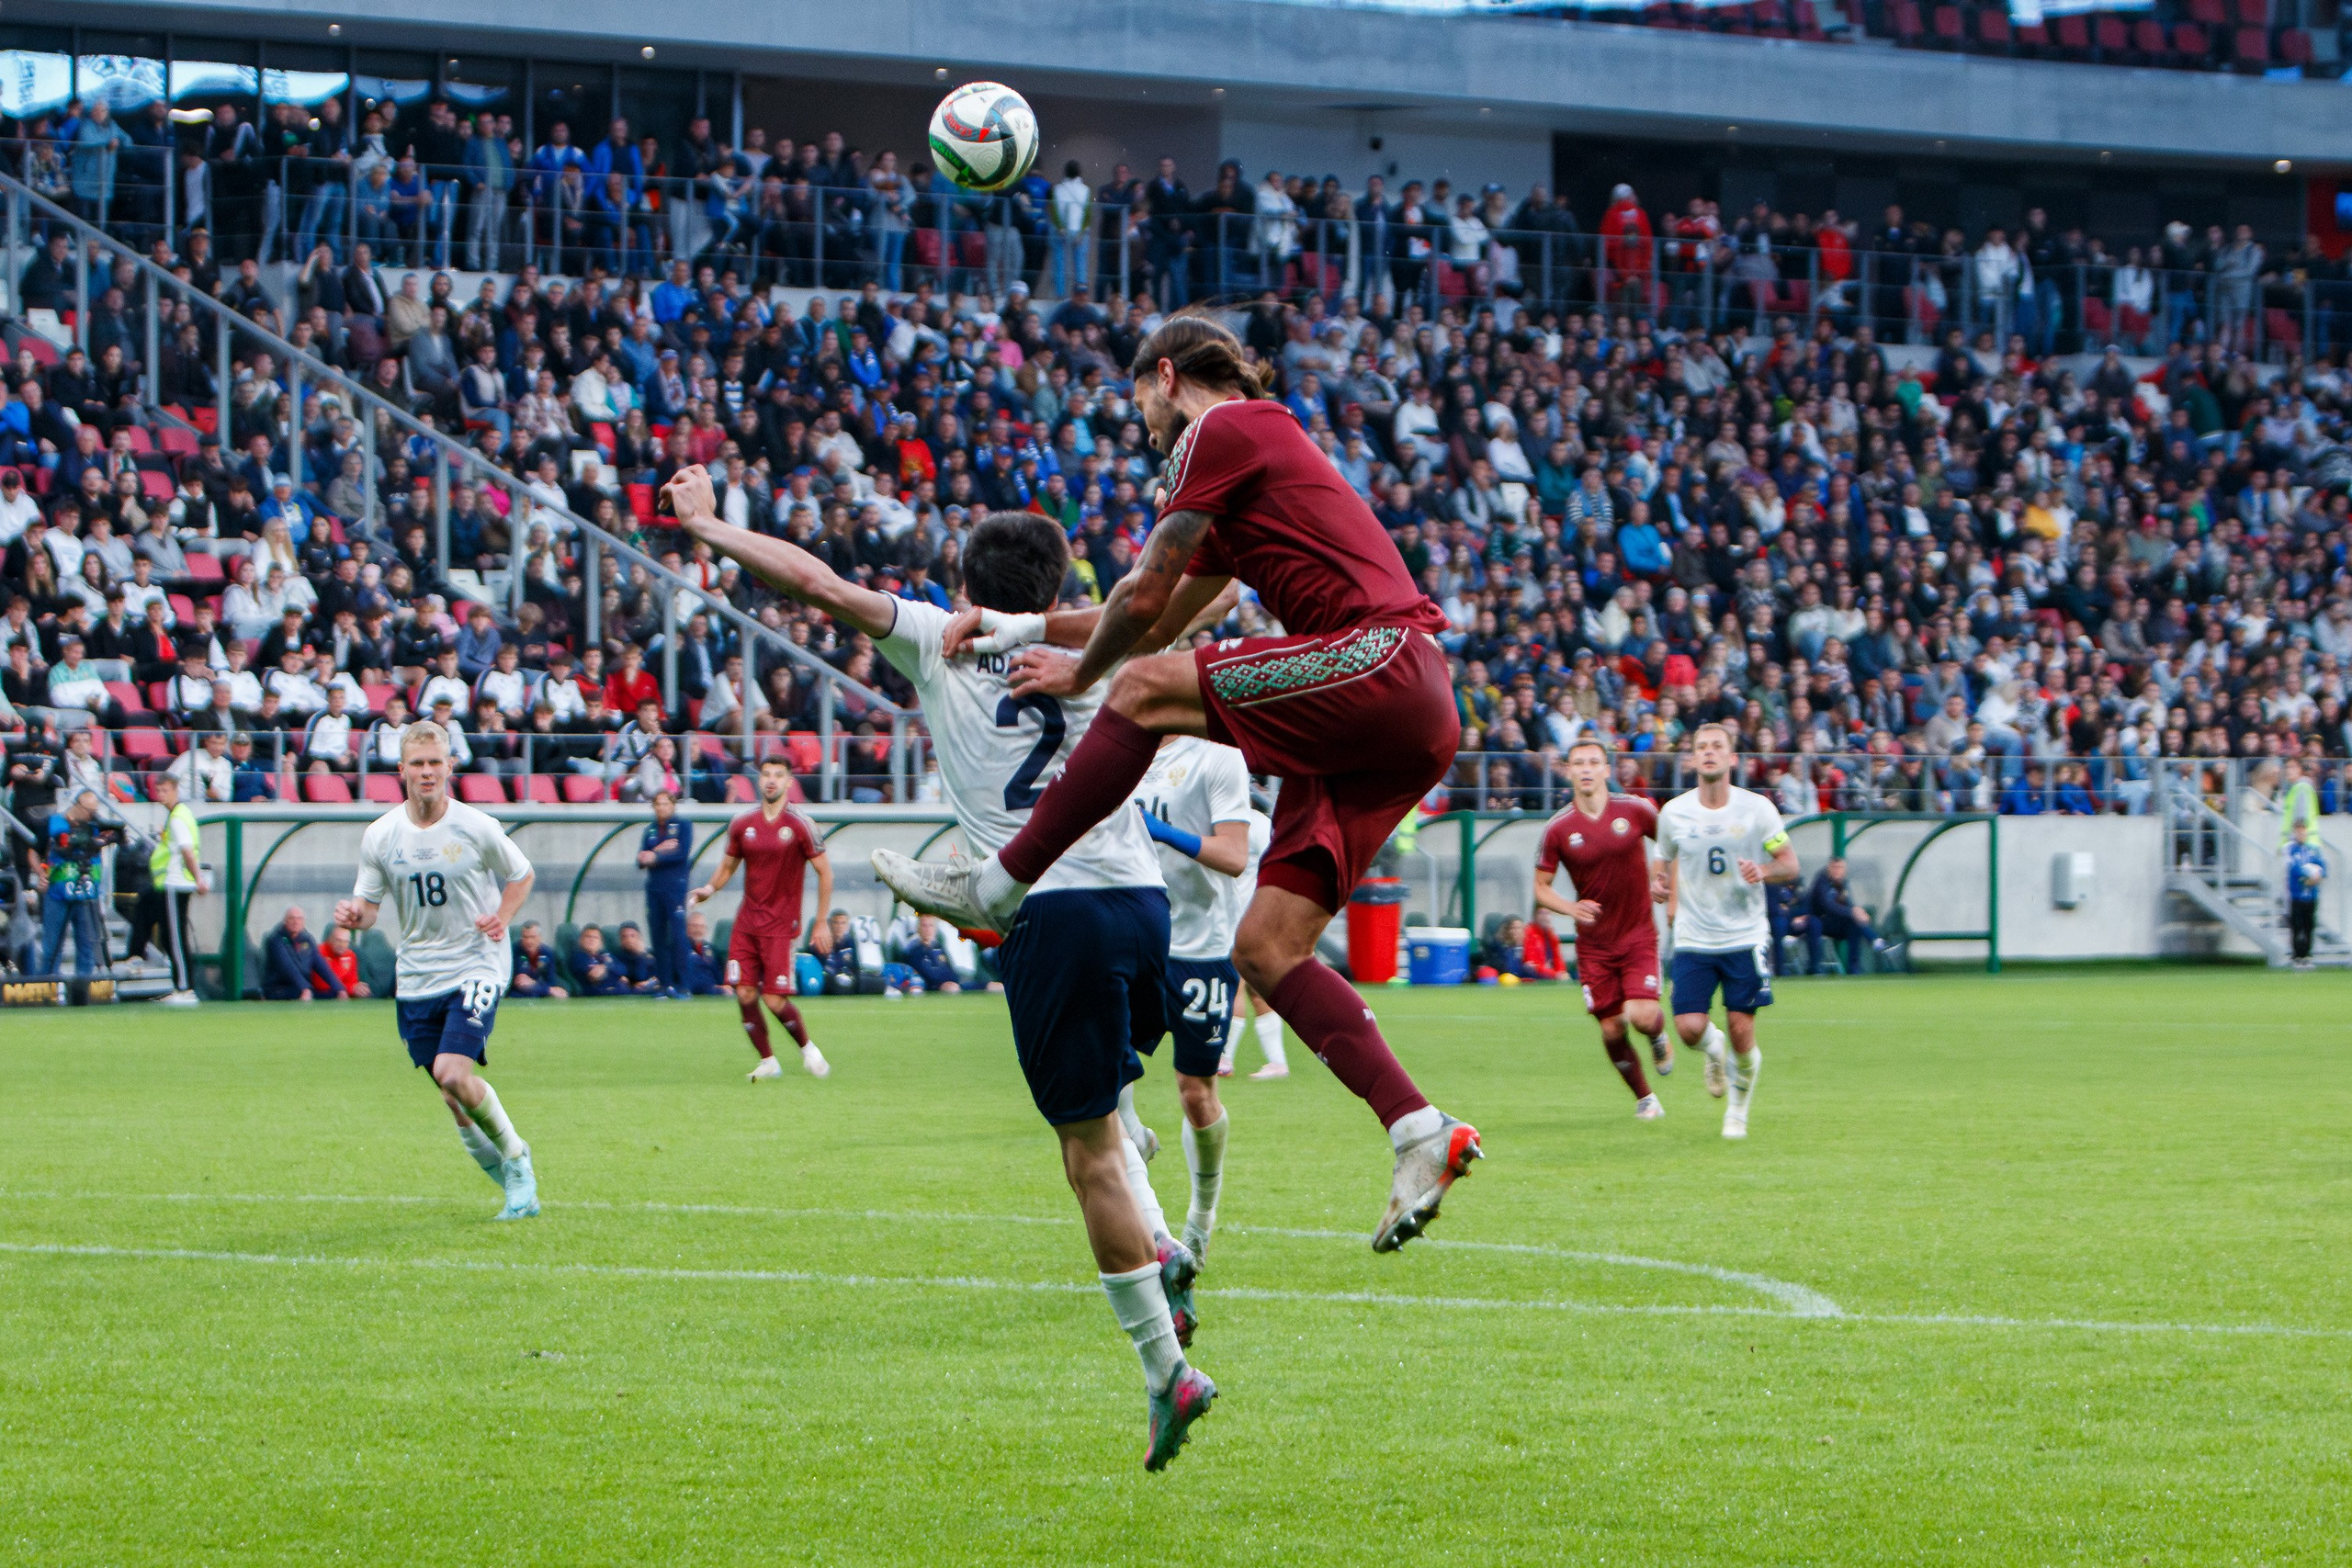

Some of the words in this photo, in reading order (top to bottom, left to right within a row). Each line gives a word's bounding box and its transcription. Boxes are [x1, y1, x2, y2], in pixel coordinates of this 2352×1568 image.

[996, 693, 1066, 811] 2
[1708, 845, 1725, 874] 6
[409, 871, 447, 907] 18
[460, 979, 497, 1011] 18
[1182, 977, 1228, 1021] 24
